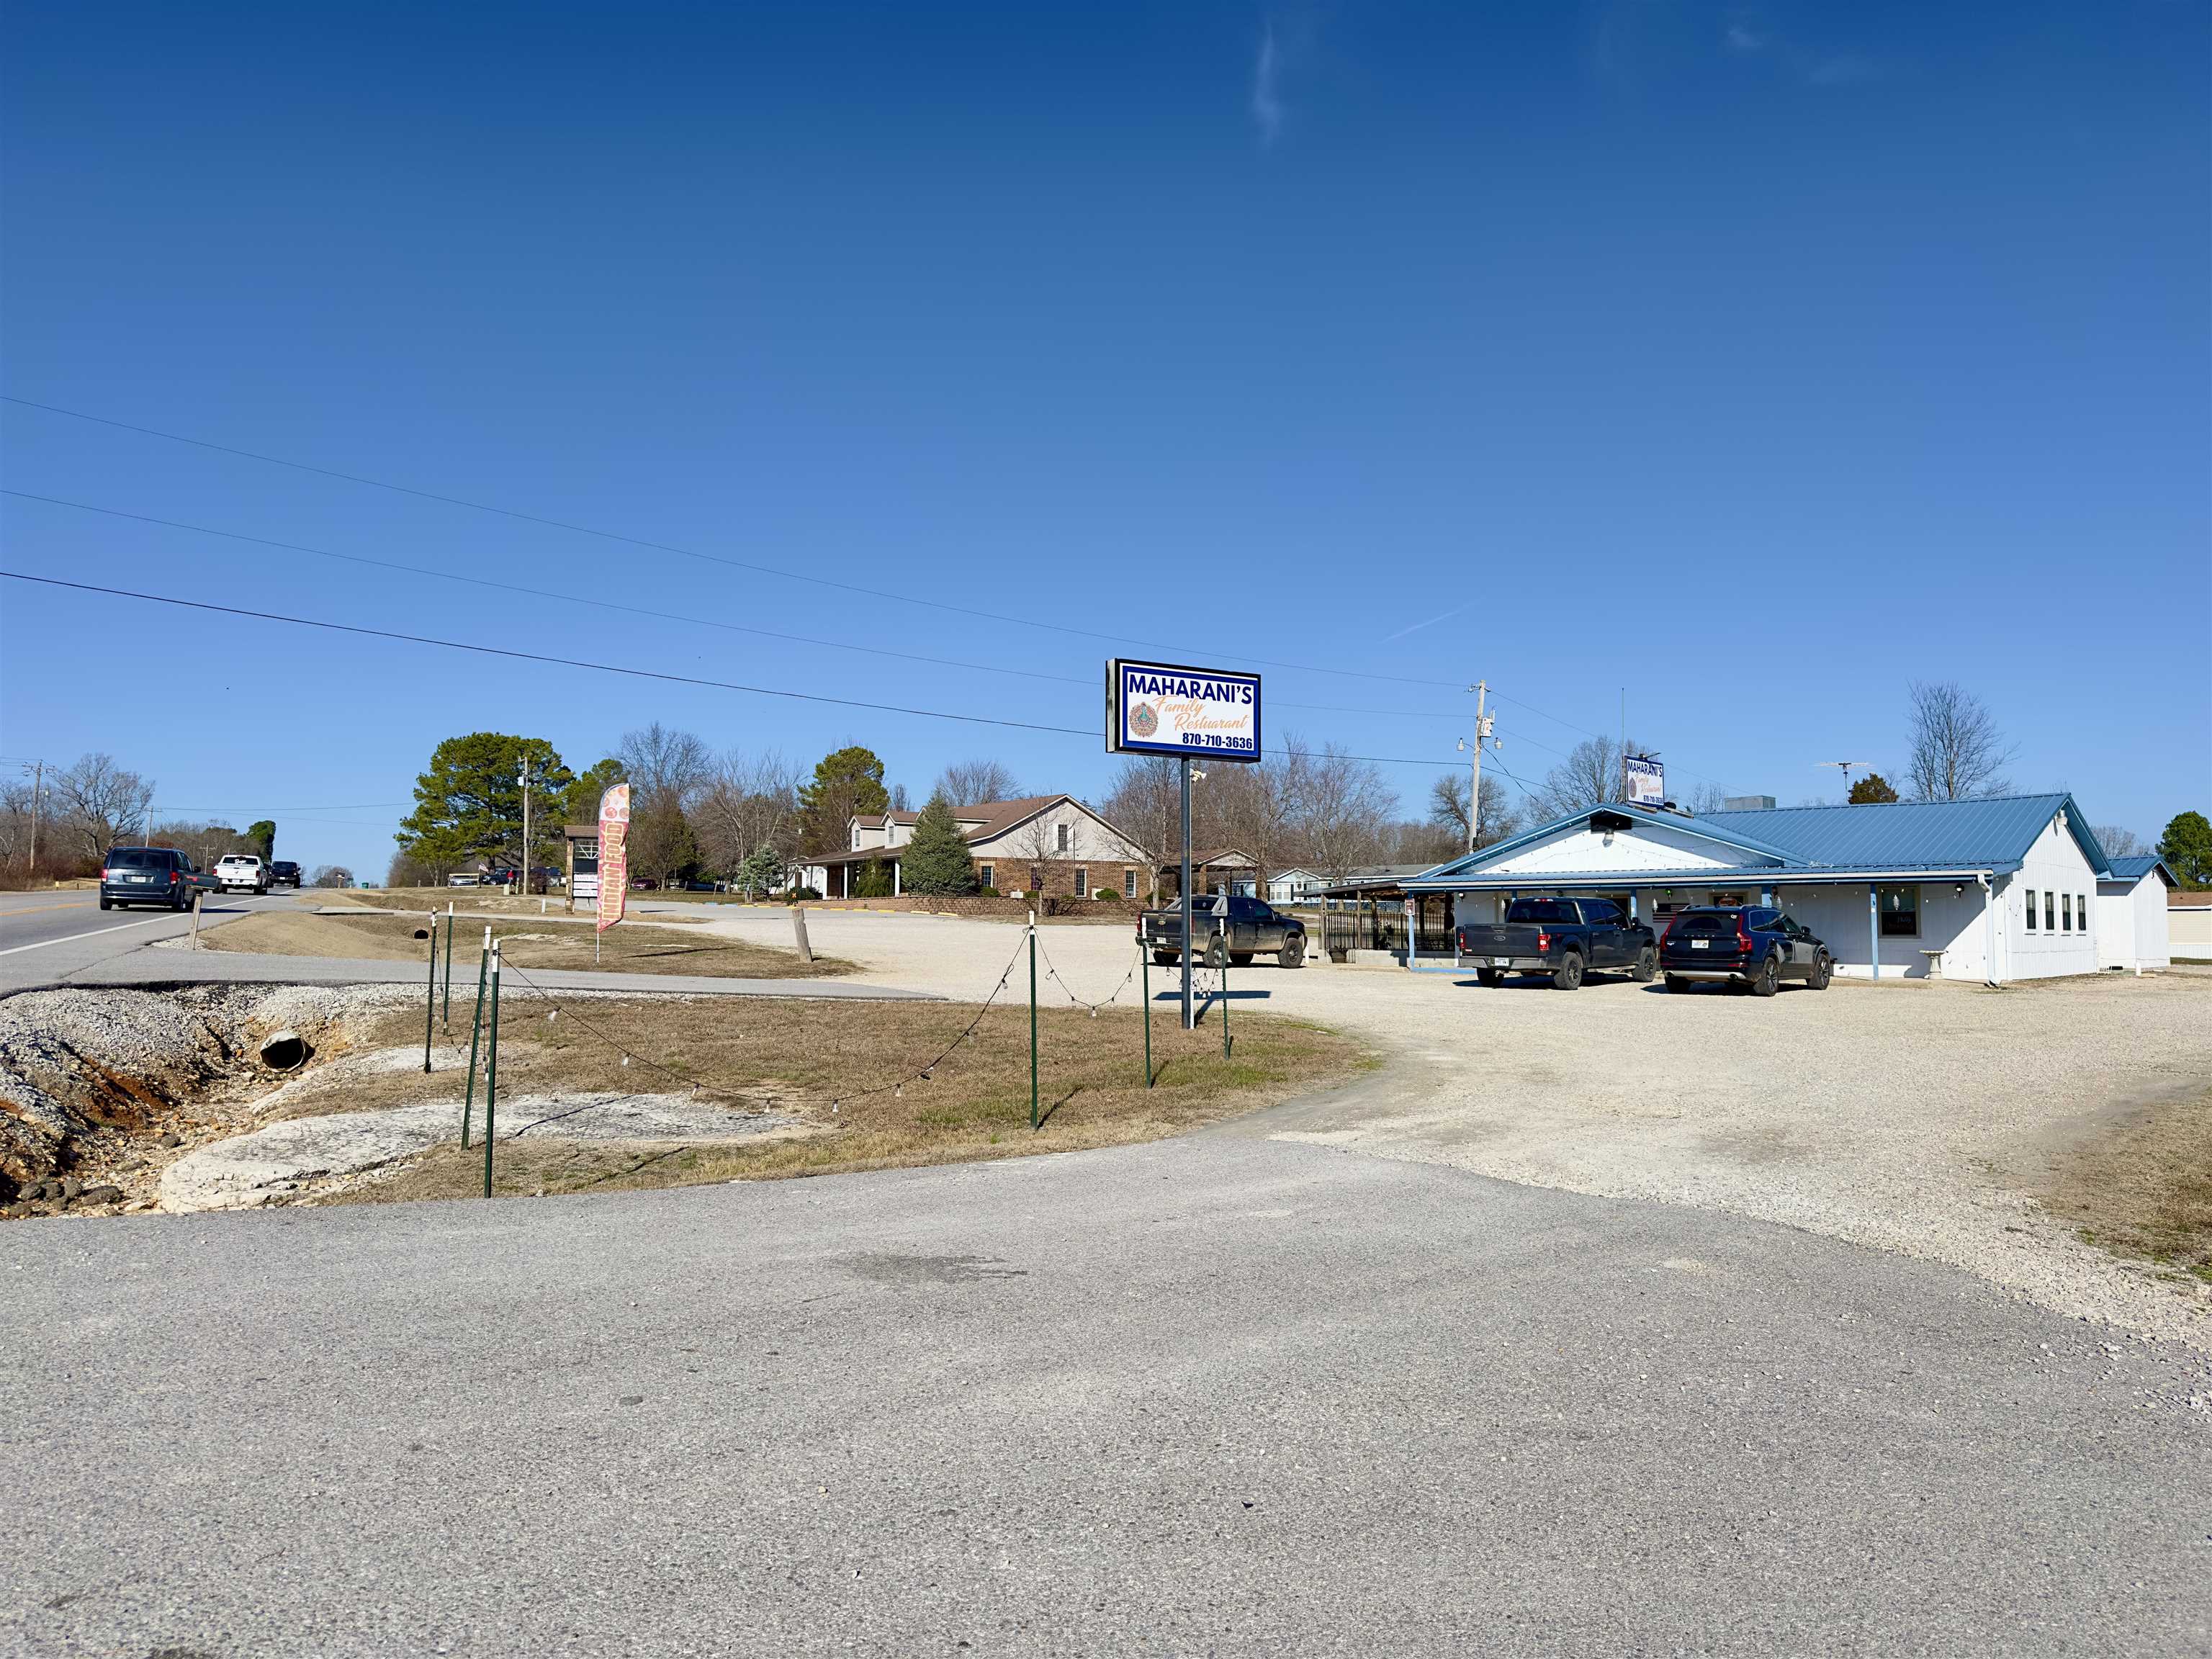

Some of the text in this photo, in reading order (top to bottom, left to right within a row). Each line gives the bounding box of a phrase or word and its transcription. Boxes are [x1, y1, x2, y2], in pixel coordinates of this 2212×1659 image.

[1129, 674, 1252, 704] MAHARANI'S
[1152, 695, 1207, 717] Family
[1174, 712, 1250, 732] Restuarant
[1182, 732, 1253, 749] 870-710-3636
[1628, 760, 1663, 778] MAHARANI'S
[602, 822, 624, 920] INDIAN FOOD
